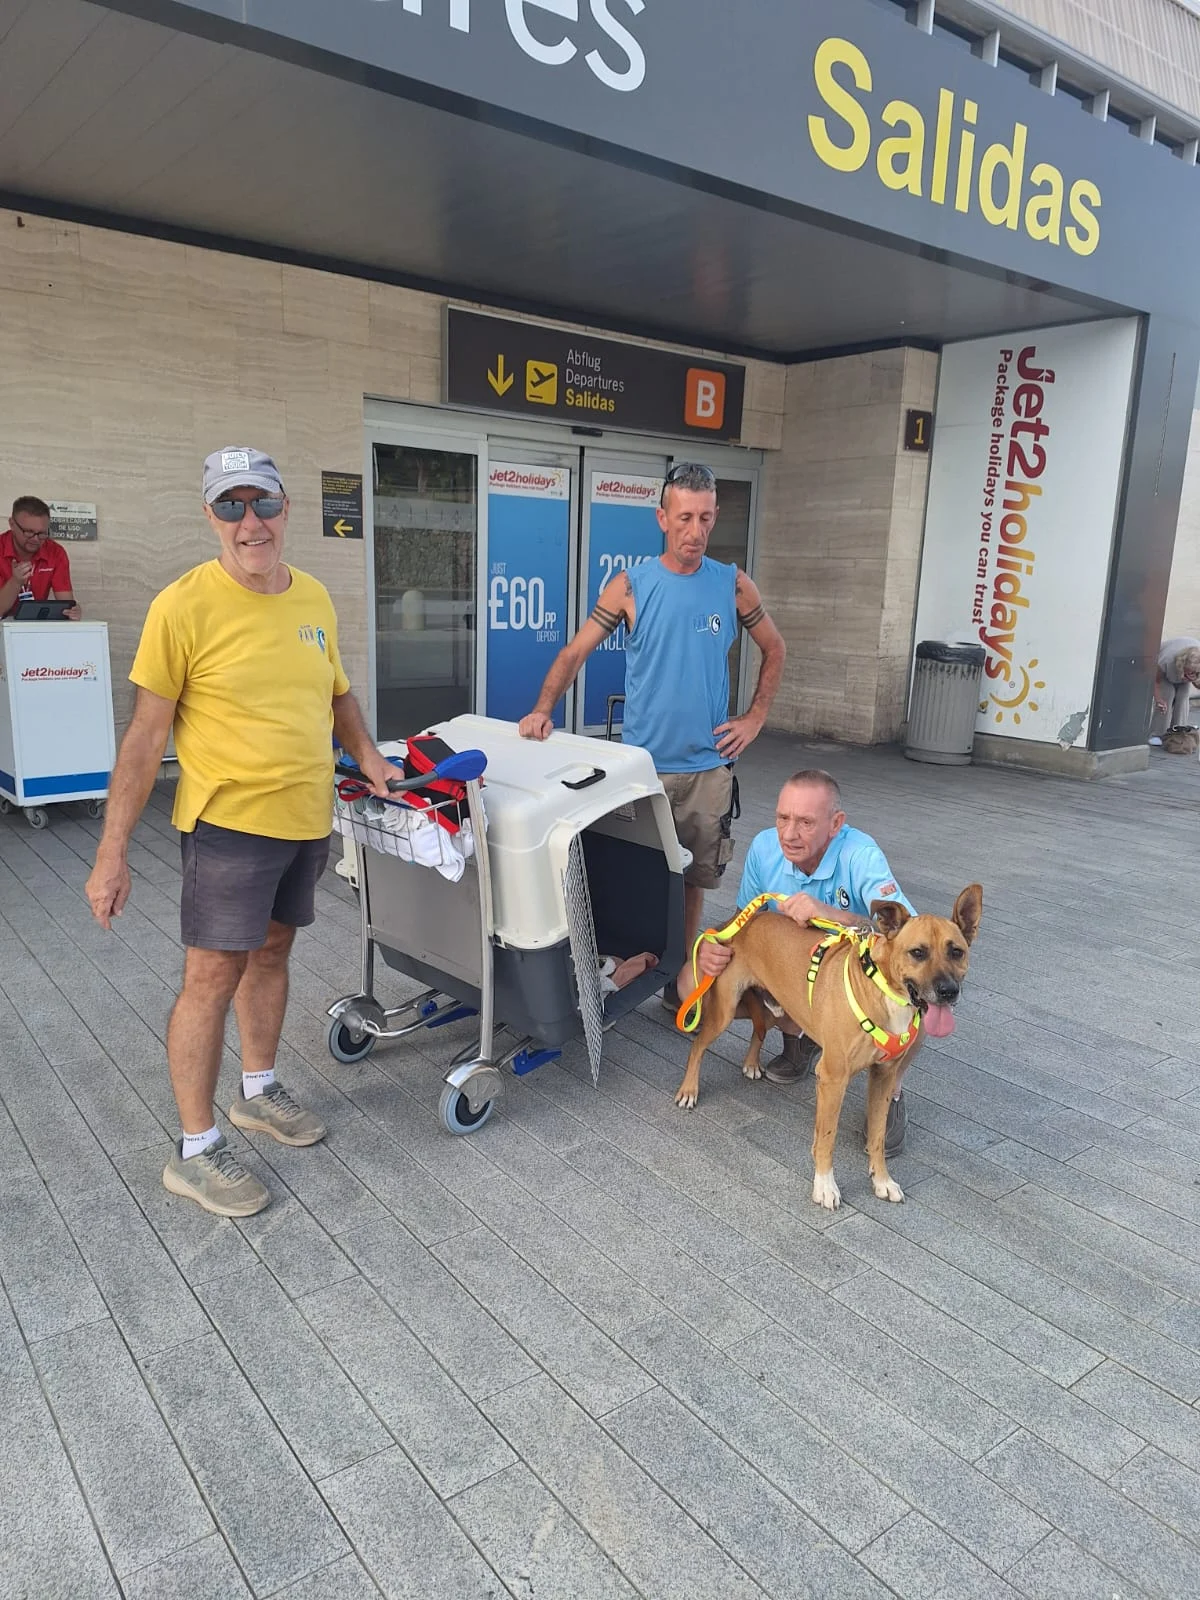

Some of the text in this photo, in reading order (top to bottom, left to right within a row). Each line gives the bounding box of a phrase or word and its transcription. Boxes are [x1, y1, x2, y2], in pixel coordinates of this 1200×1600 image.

[807, 37, 1102, 256] Salidas
[566, 349, 601, 371] Abflug
[565, 368, 625, 392] Departures
[565, 388, 615, 412] Salidas
[696, 379, 716, 418] B
[914, 417, 924, 444] 1
[972, 349, 1013, 625] Package holidays you can trust
[490, 562, 507, 575] JUST
[488, 576, 545, 630] £60
[536, 630, 561, 643] DEPOSIT
